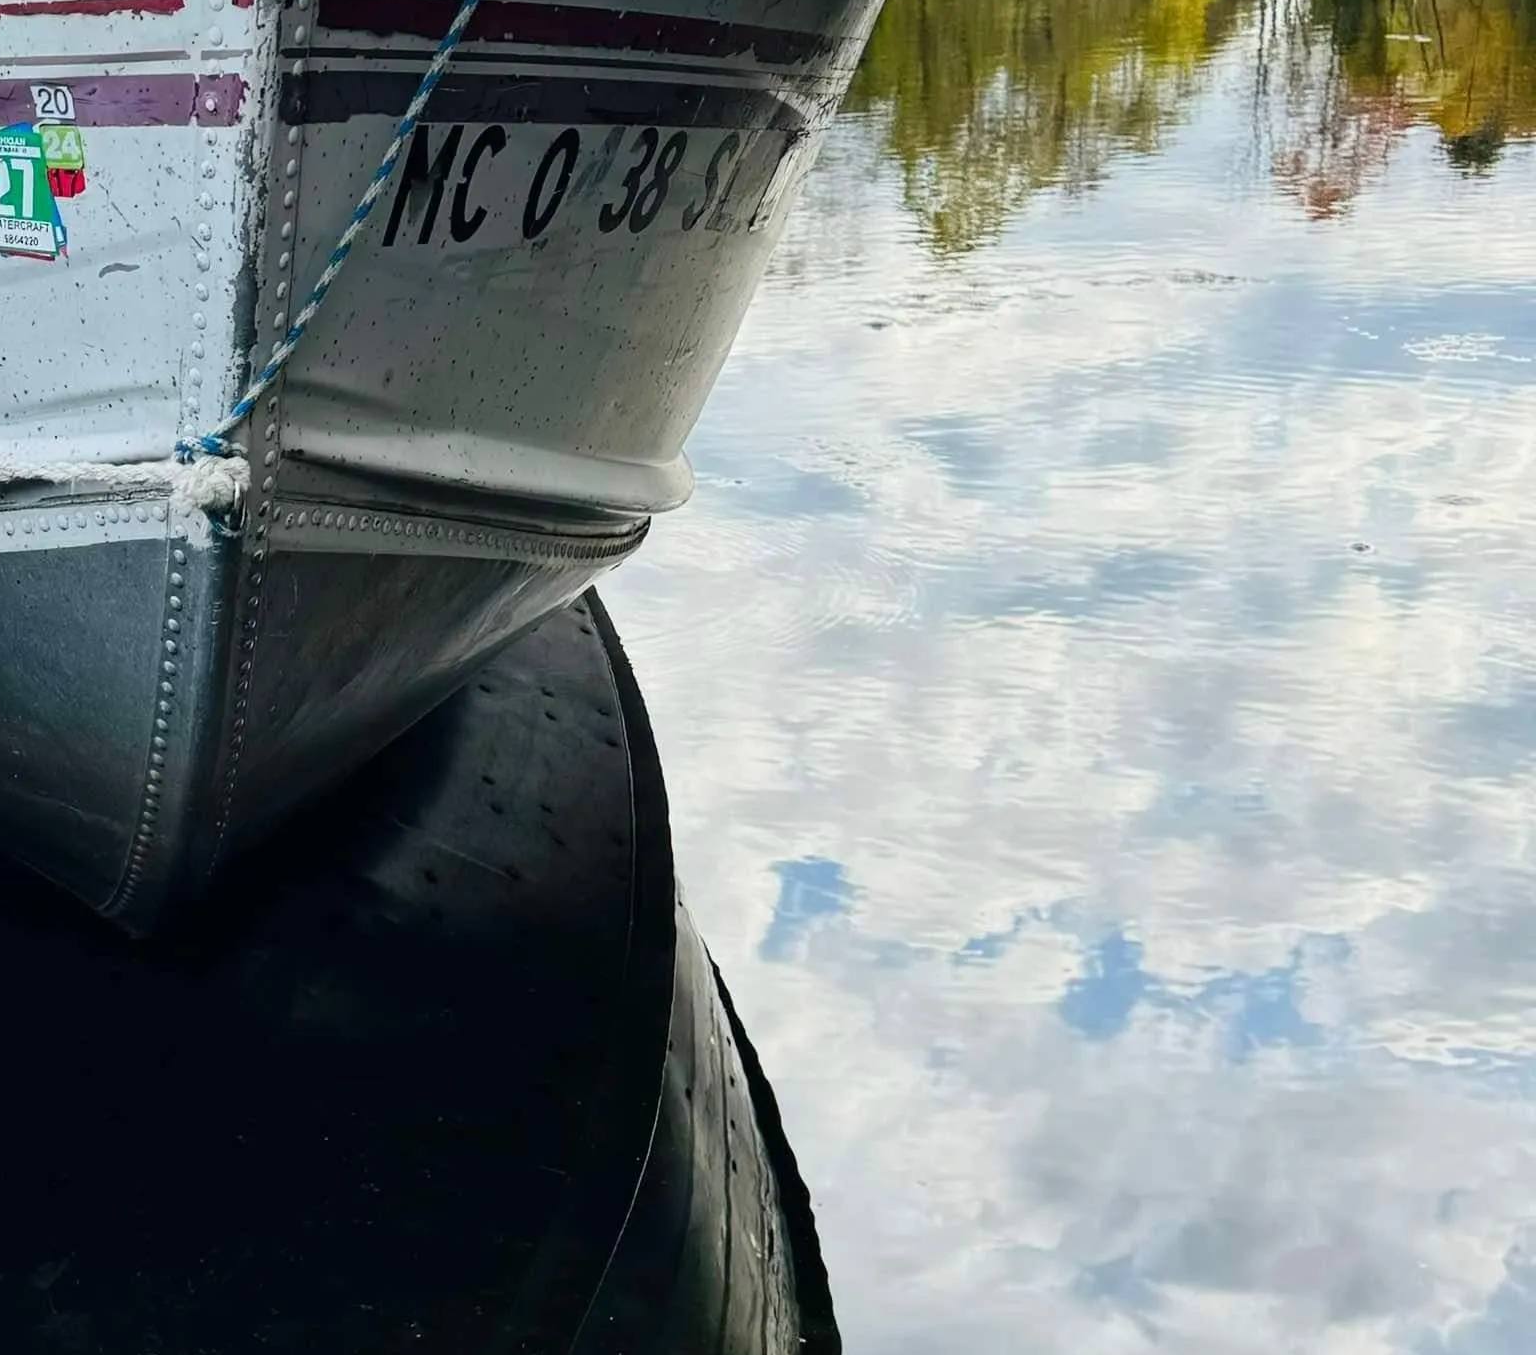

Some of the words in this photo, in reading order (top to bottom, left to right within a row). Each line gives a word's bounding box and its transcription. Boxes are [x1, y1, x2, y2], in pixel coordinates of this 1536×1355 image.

[38, 88, 69, 115] 20
[43, 130, 81, 161] 24
[381, 124, 507, 247] MC
